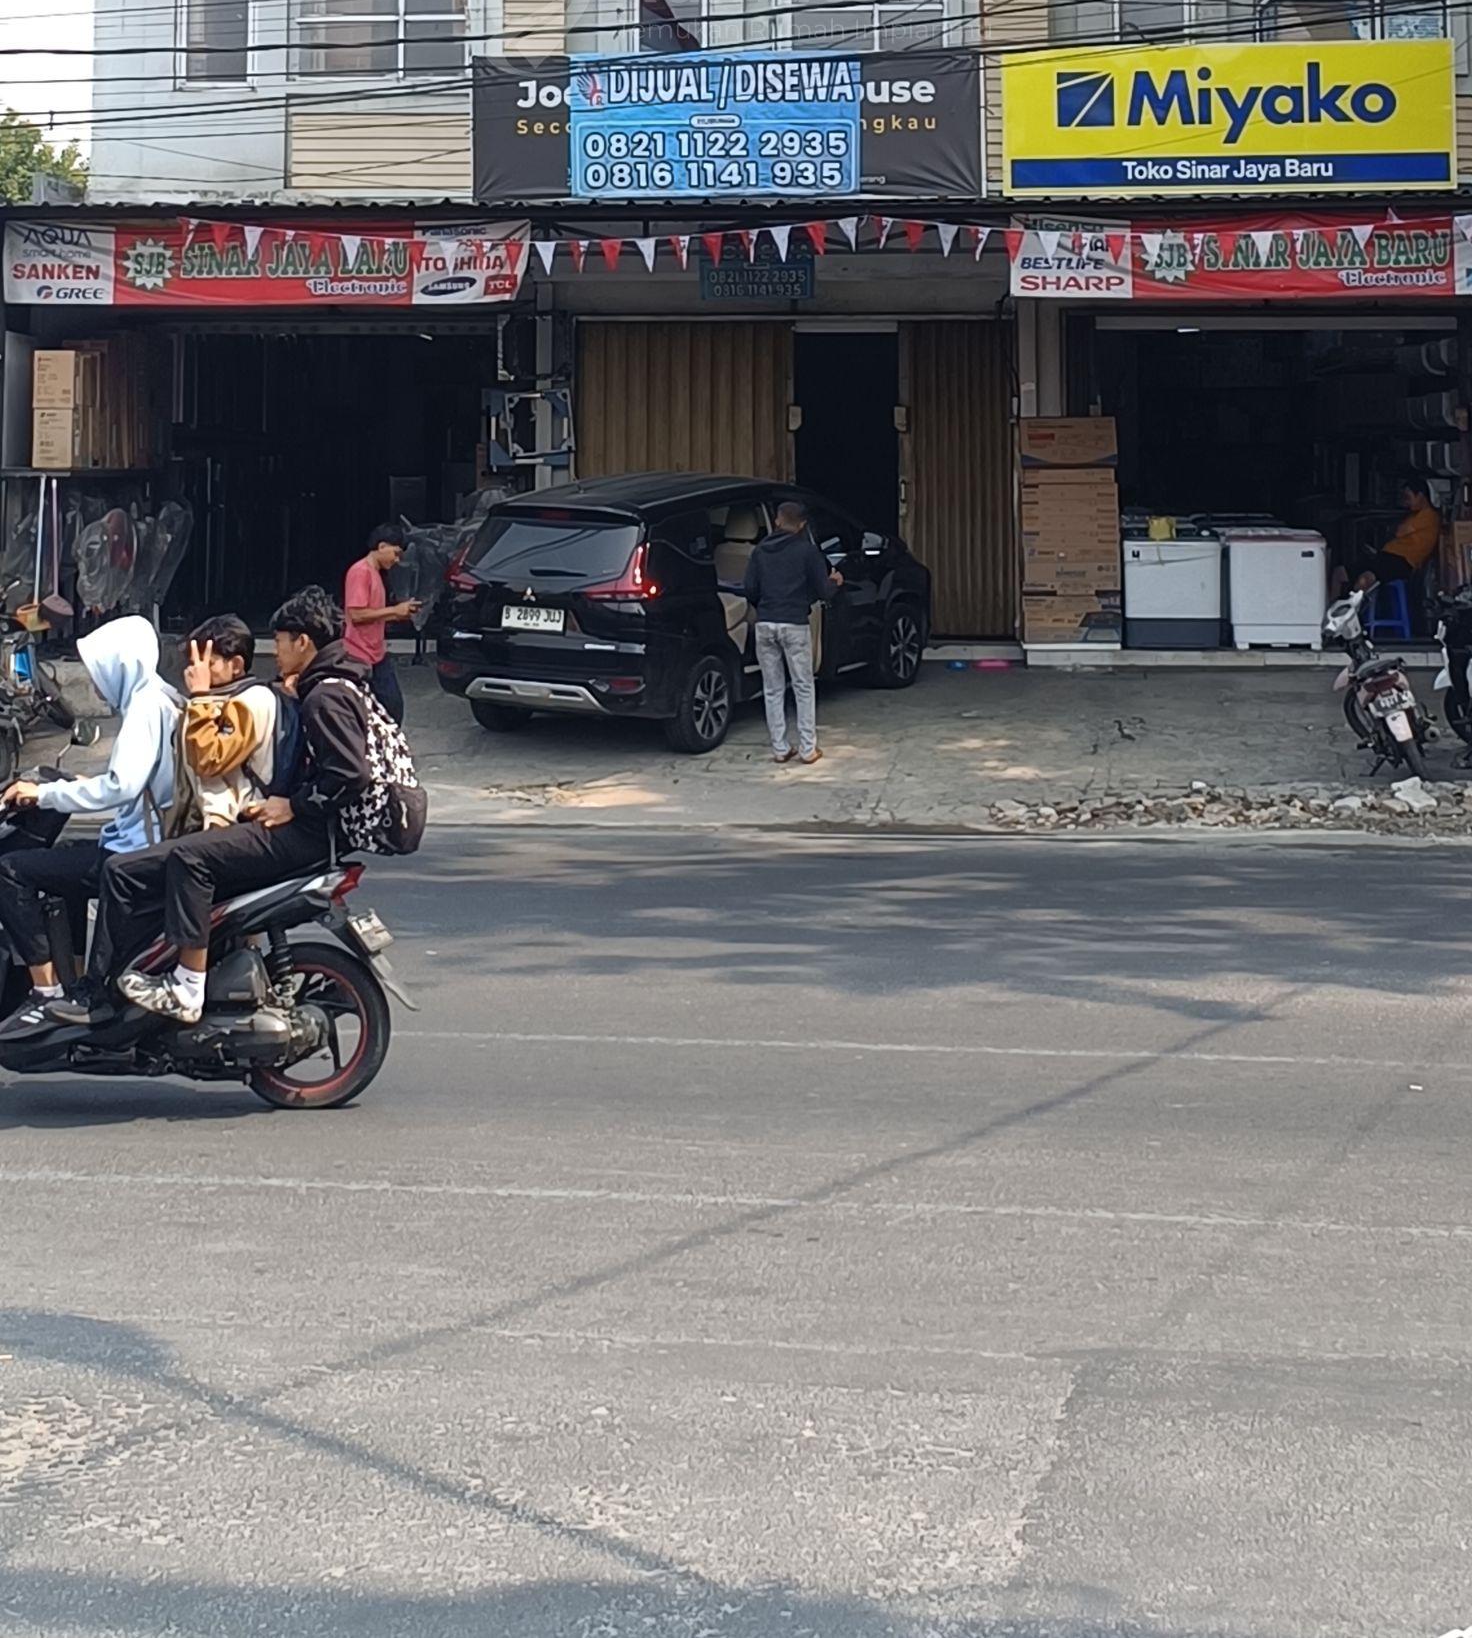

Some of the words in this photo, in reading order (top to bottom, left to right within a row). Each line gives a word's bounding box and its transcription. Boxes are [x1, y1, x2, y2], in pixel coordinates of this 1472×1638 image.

[608, 64, 714, 103] DIJUAL
[734, 61, 856, 102] DISEWA
[1127, 62, 1396, 143] Miyako
[585, 132, 665, 158] 0821
[676, 131, 749, 157] 1122
[759, 130, 849, 157] 2935
[585, 162, 674, 189] 0816
[686, 161, 758, 188] 1141
[771, 161, 843, 187] 935
[1122, 161, 1172, 179] Toko
[1176, 160, 1230, 178] Sinar
[1233, 160, 1281, 182] Jaya
[1284, 159, 1333, 177] Baru
[24, 228, 92, 246] AQUA
[1204, 233, 1291, 269] SNAR
[1373, 229, 1450, 268] BARU
[12, 264, 100, 280] SANKEN
[134, 253, 166, 275] SJB
[56, 287, 105, 300] GREE
[488, 281, 512, 289] TCL
[1020, 275, 1125, 291] SHARP
